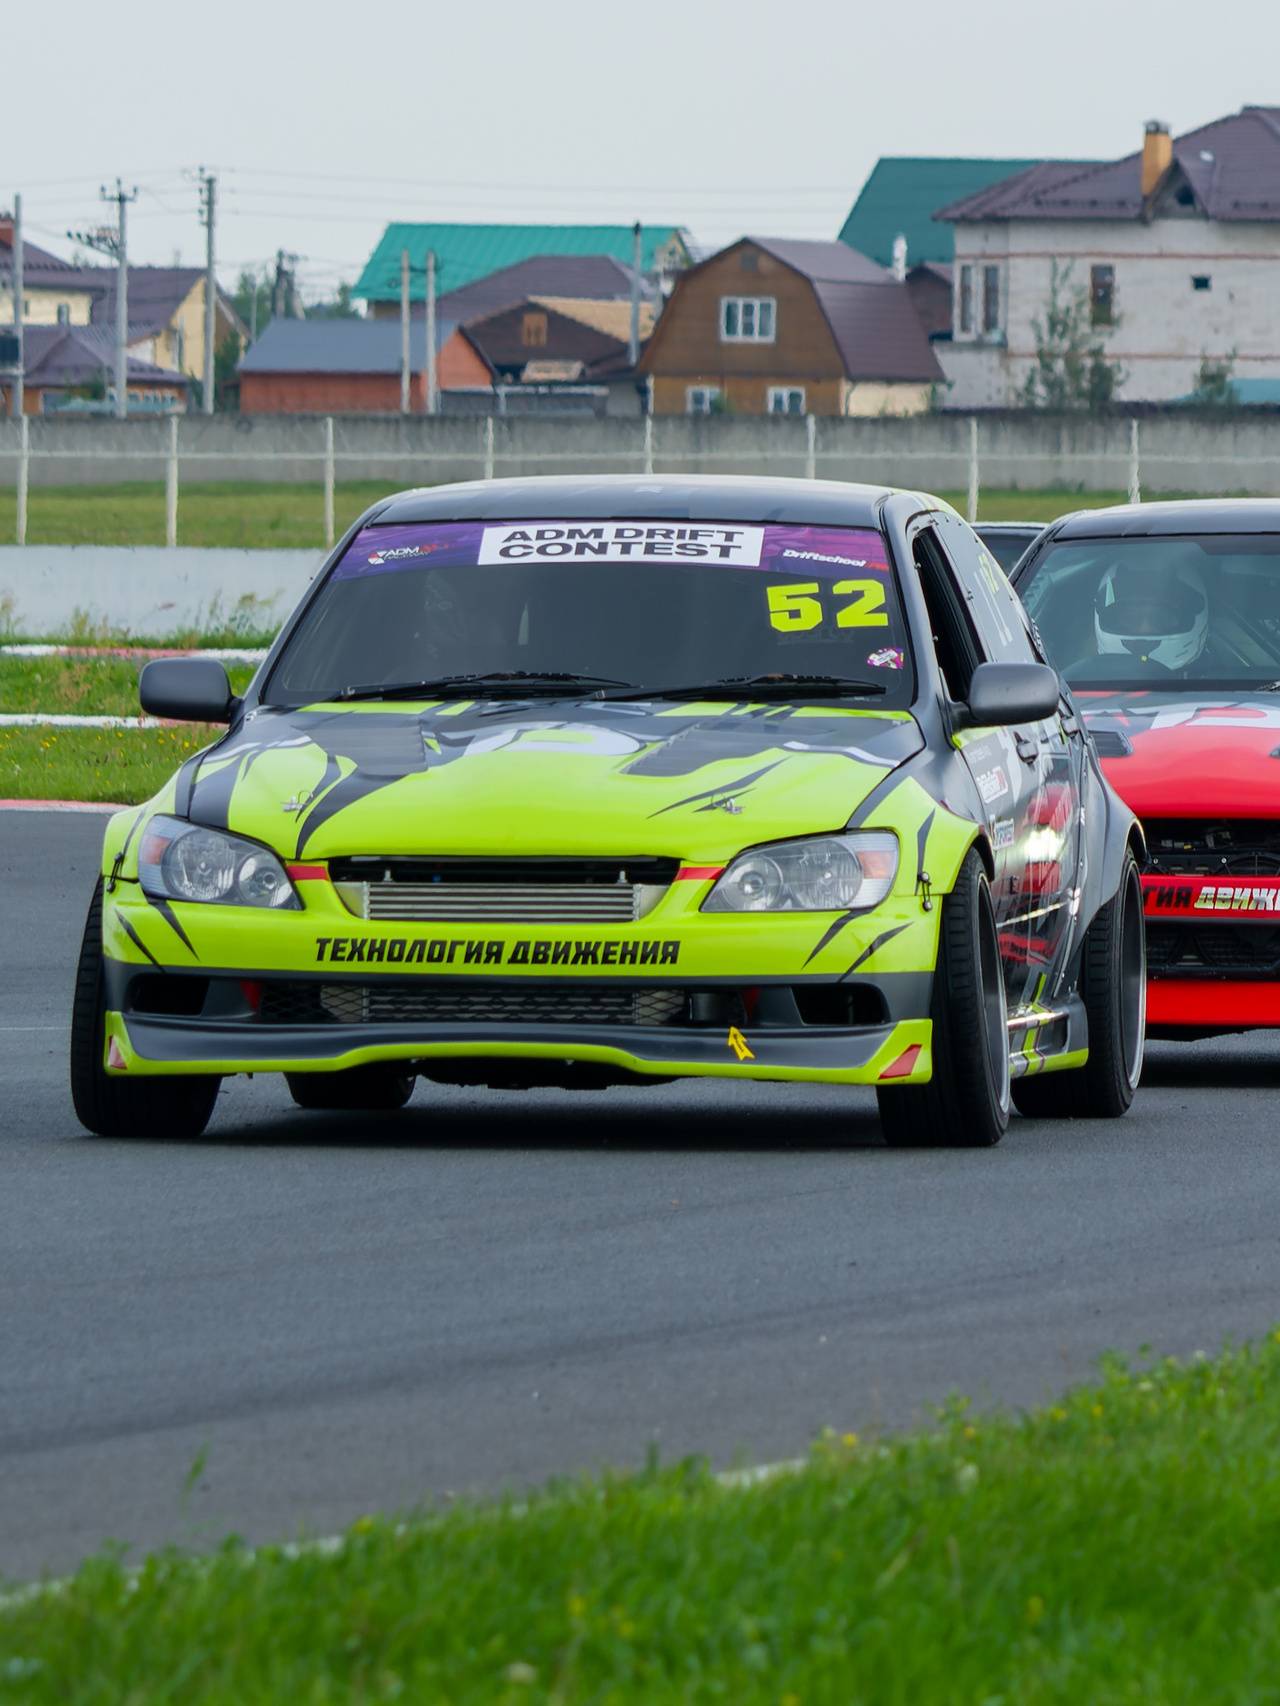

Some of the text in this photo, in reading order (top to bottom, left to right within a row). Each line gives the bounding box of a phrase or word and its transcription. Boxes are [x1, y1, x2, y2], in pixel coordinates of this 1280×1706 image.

[502, 528, 744, 543] ADM DRIFT
[385, 545, 420, 558] ADM
[499, 541, 742, 559] CONTEST
[783, 549, 867, 567] Driftschool
[766, 579, 889, 632] 52
[315, 938, 681, 965] ТЕХНОЛОГИЯ ДВИЖЕНИЯ
